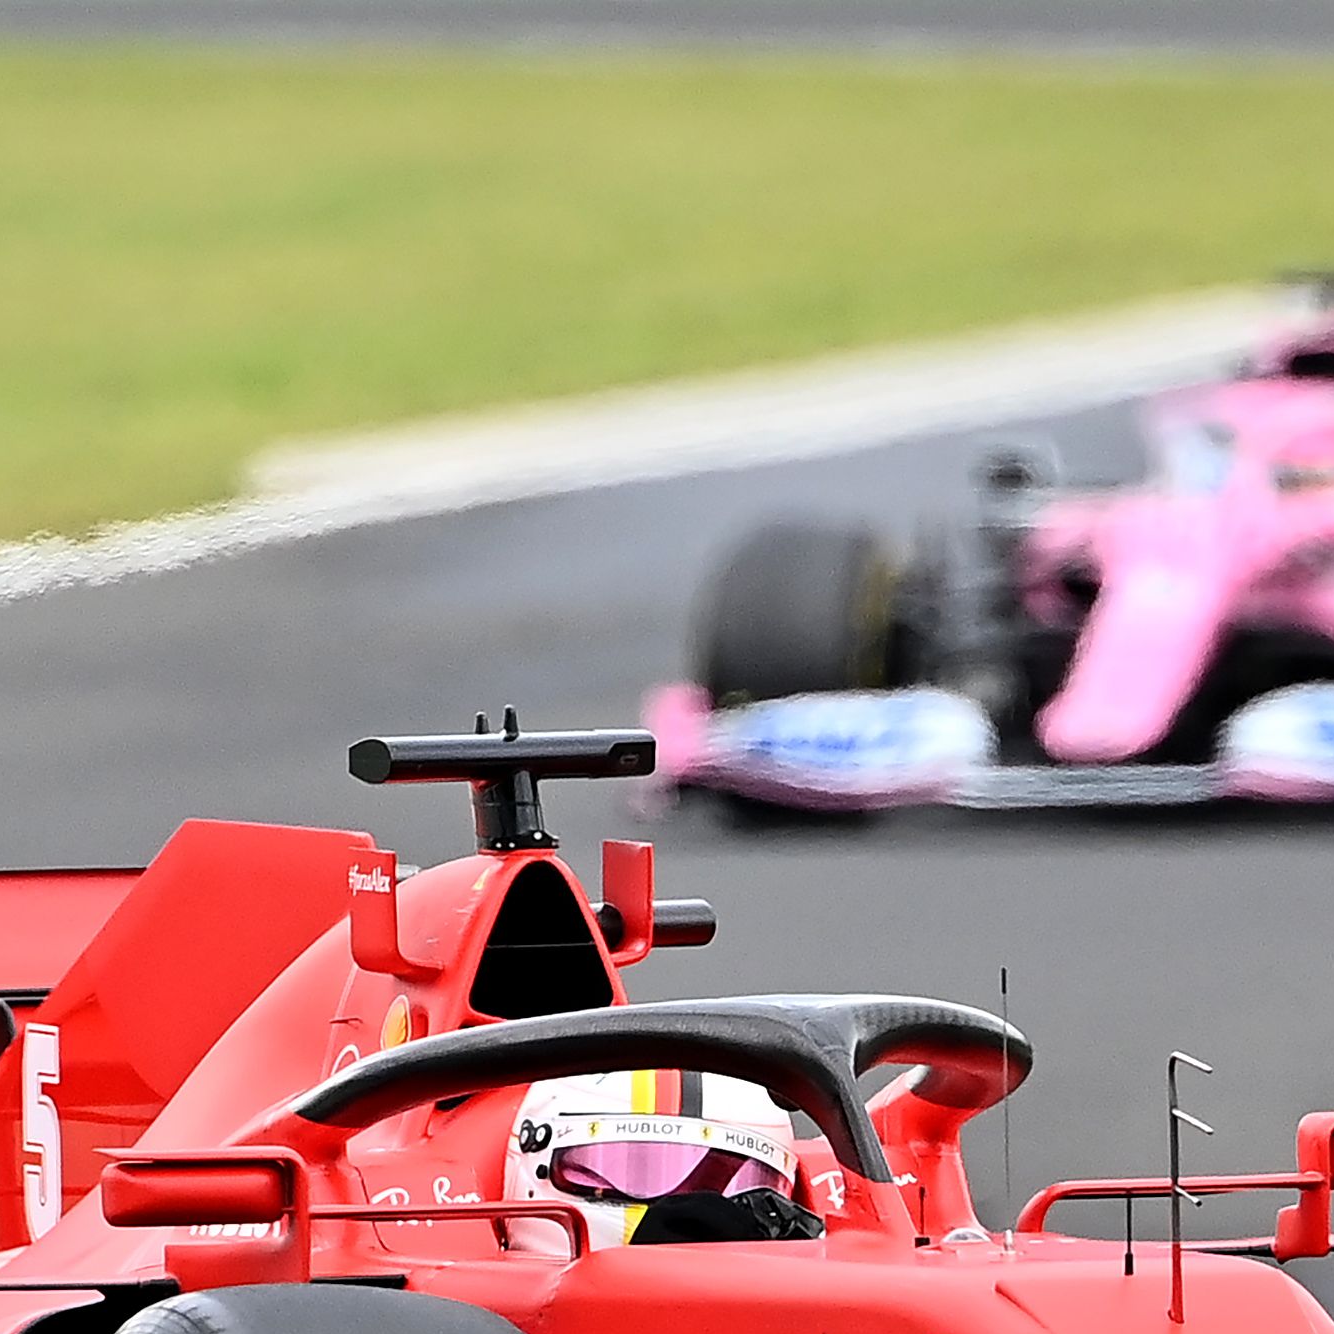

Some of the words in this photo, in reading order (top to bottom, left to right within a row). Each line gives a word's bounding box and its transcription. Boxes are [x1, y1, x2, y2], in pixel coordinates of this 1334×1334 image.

[22, 1022, 61, 1240] 5
[616, 1123, 683, 1136] HUBLOT
[725, 1132, 775, 1159] HUBLOT
